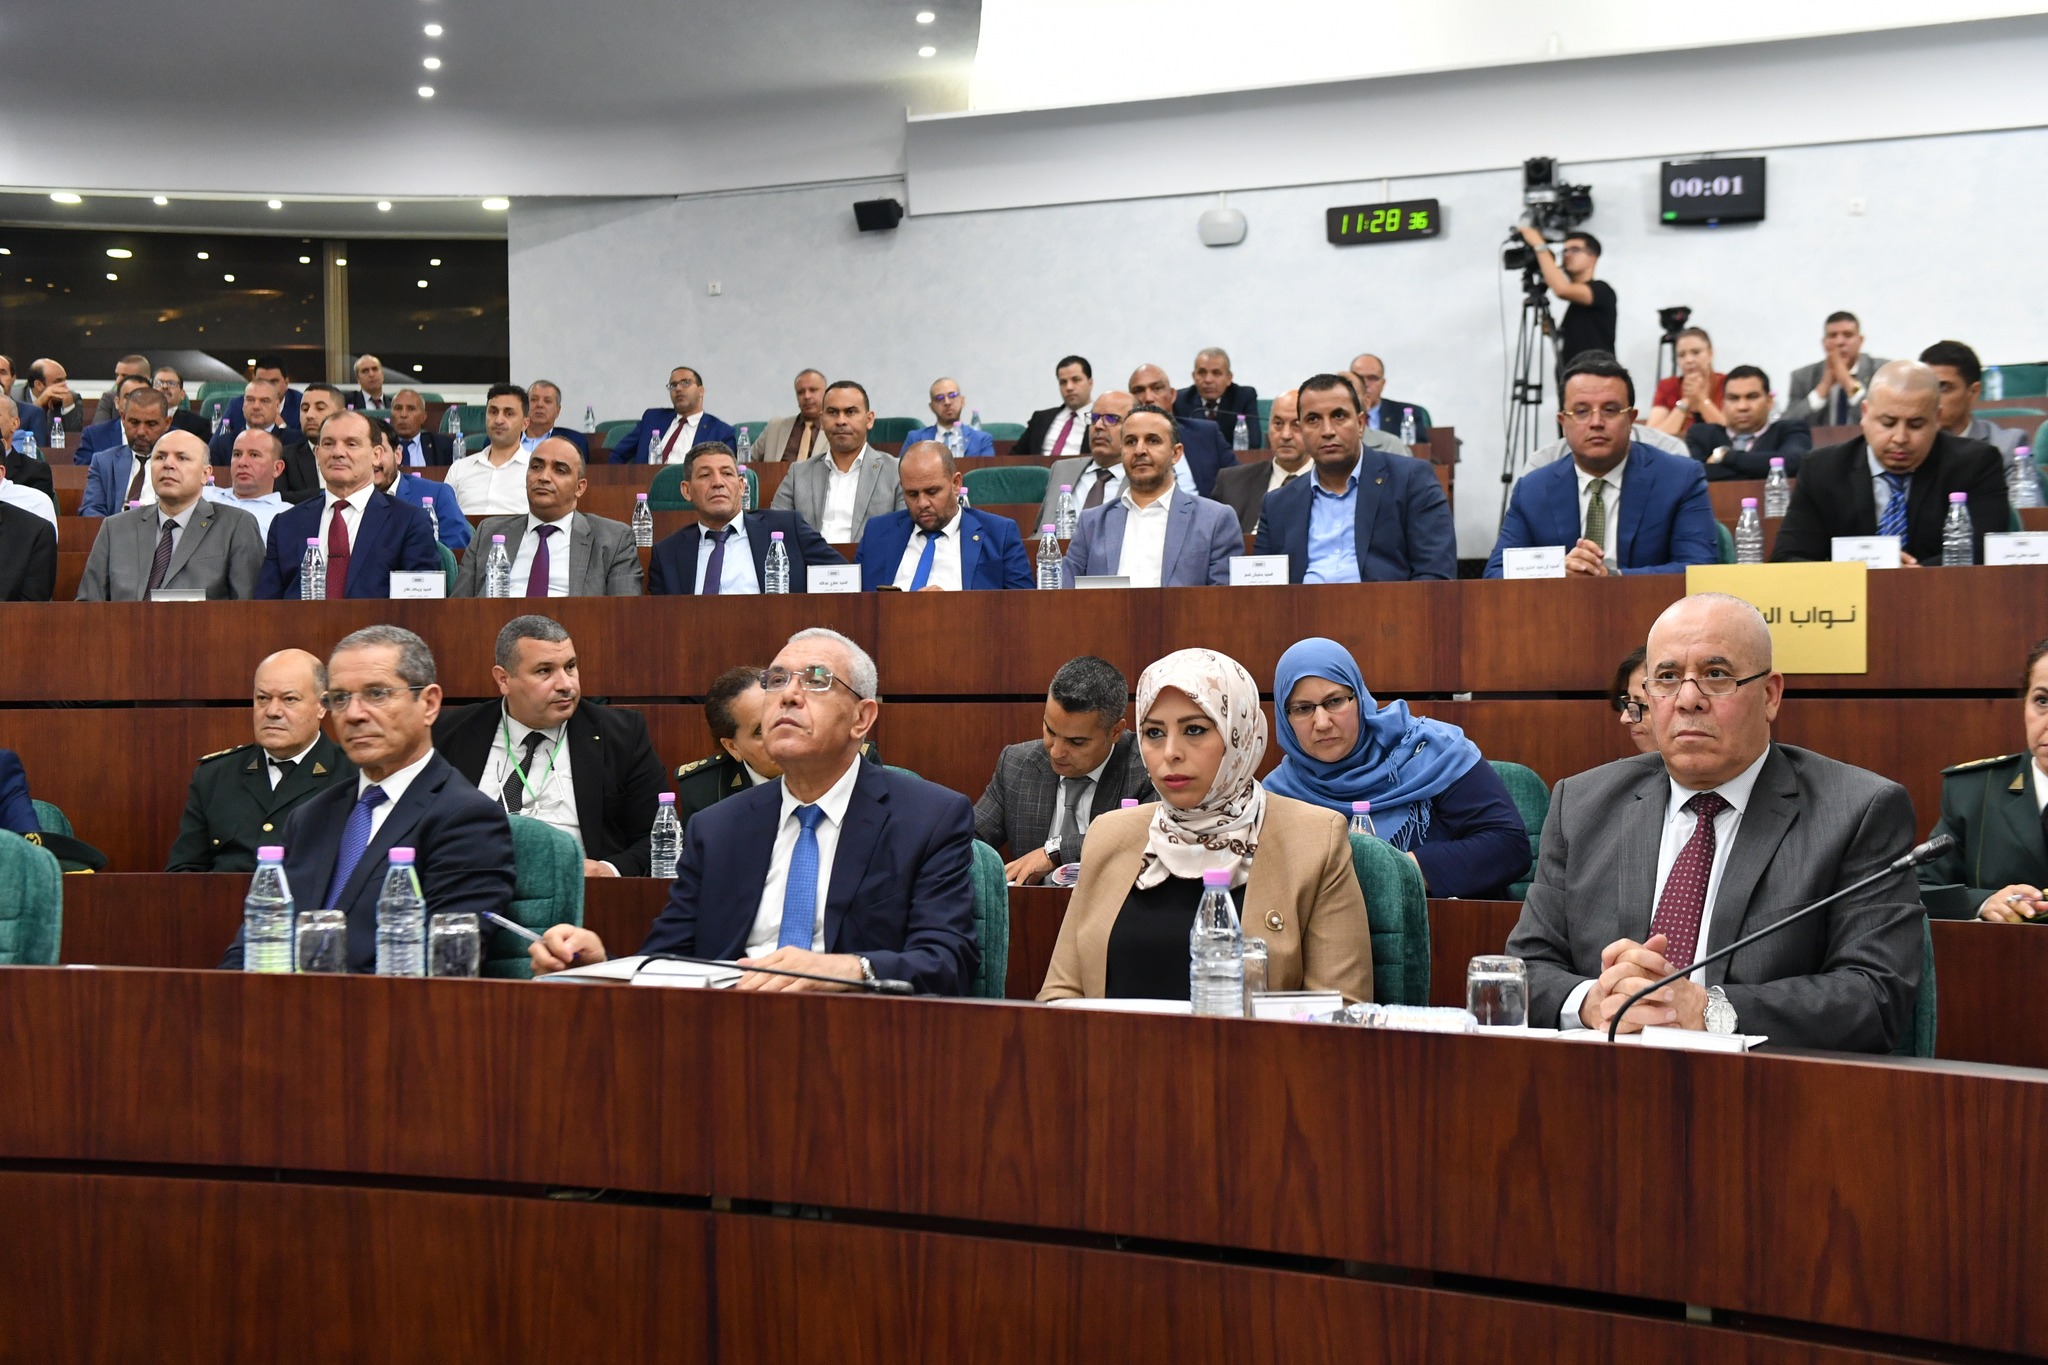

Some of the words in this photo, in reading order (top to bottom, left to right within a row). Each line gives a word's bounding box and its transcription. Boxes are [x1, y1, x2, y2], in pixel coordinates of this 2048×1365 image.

[1670, 175, 1744, 198] 00:01
[1341, 208, 1402, 235] 11:28
[1407, 211, 1430, 231] 36
[1790, 605, 1856, 629] نواب
